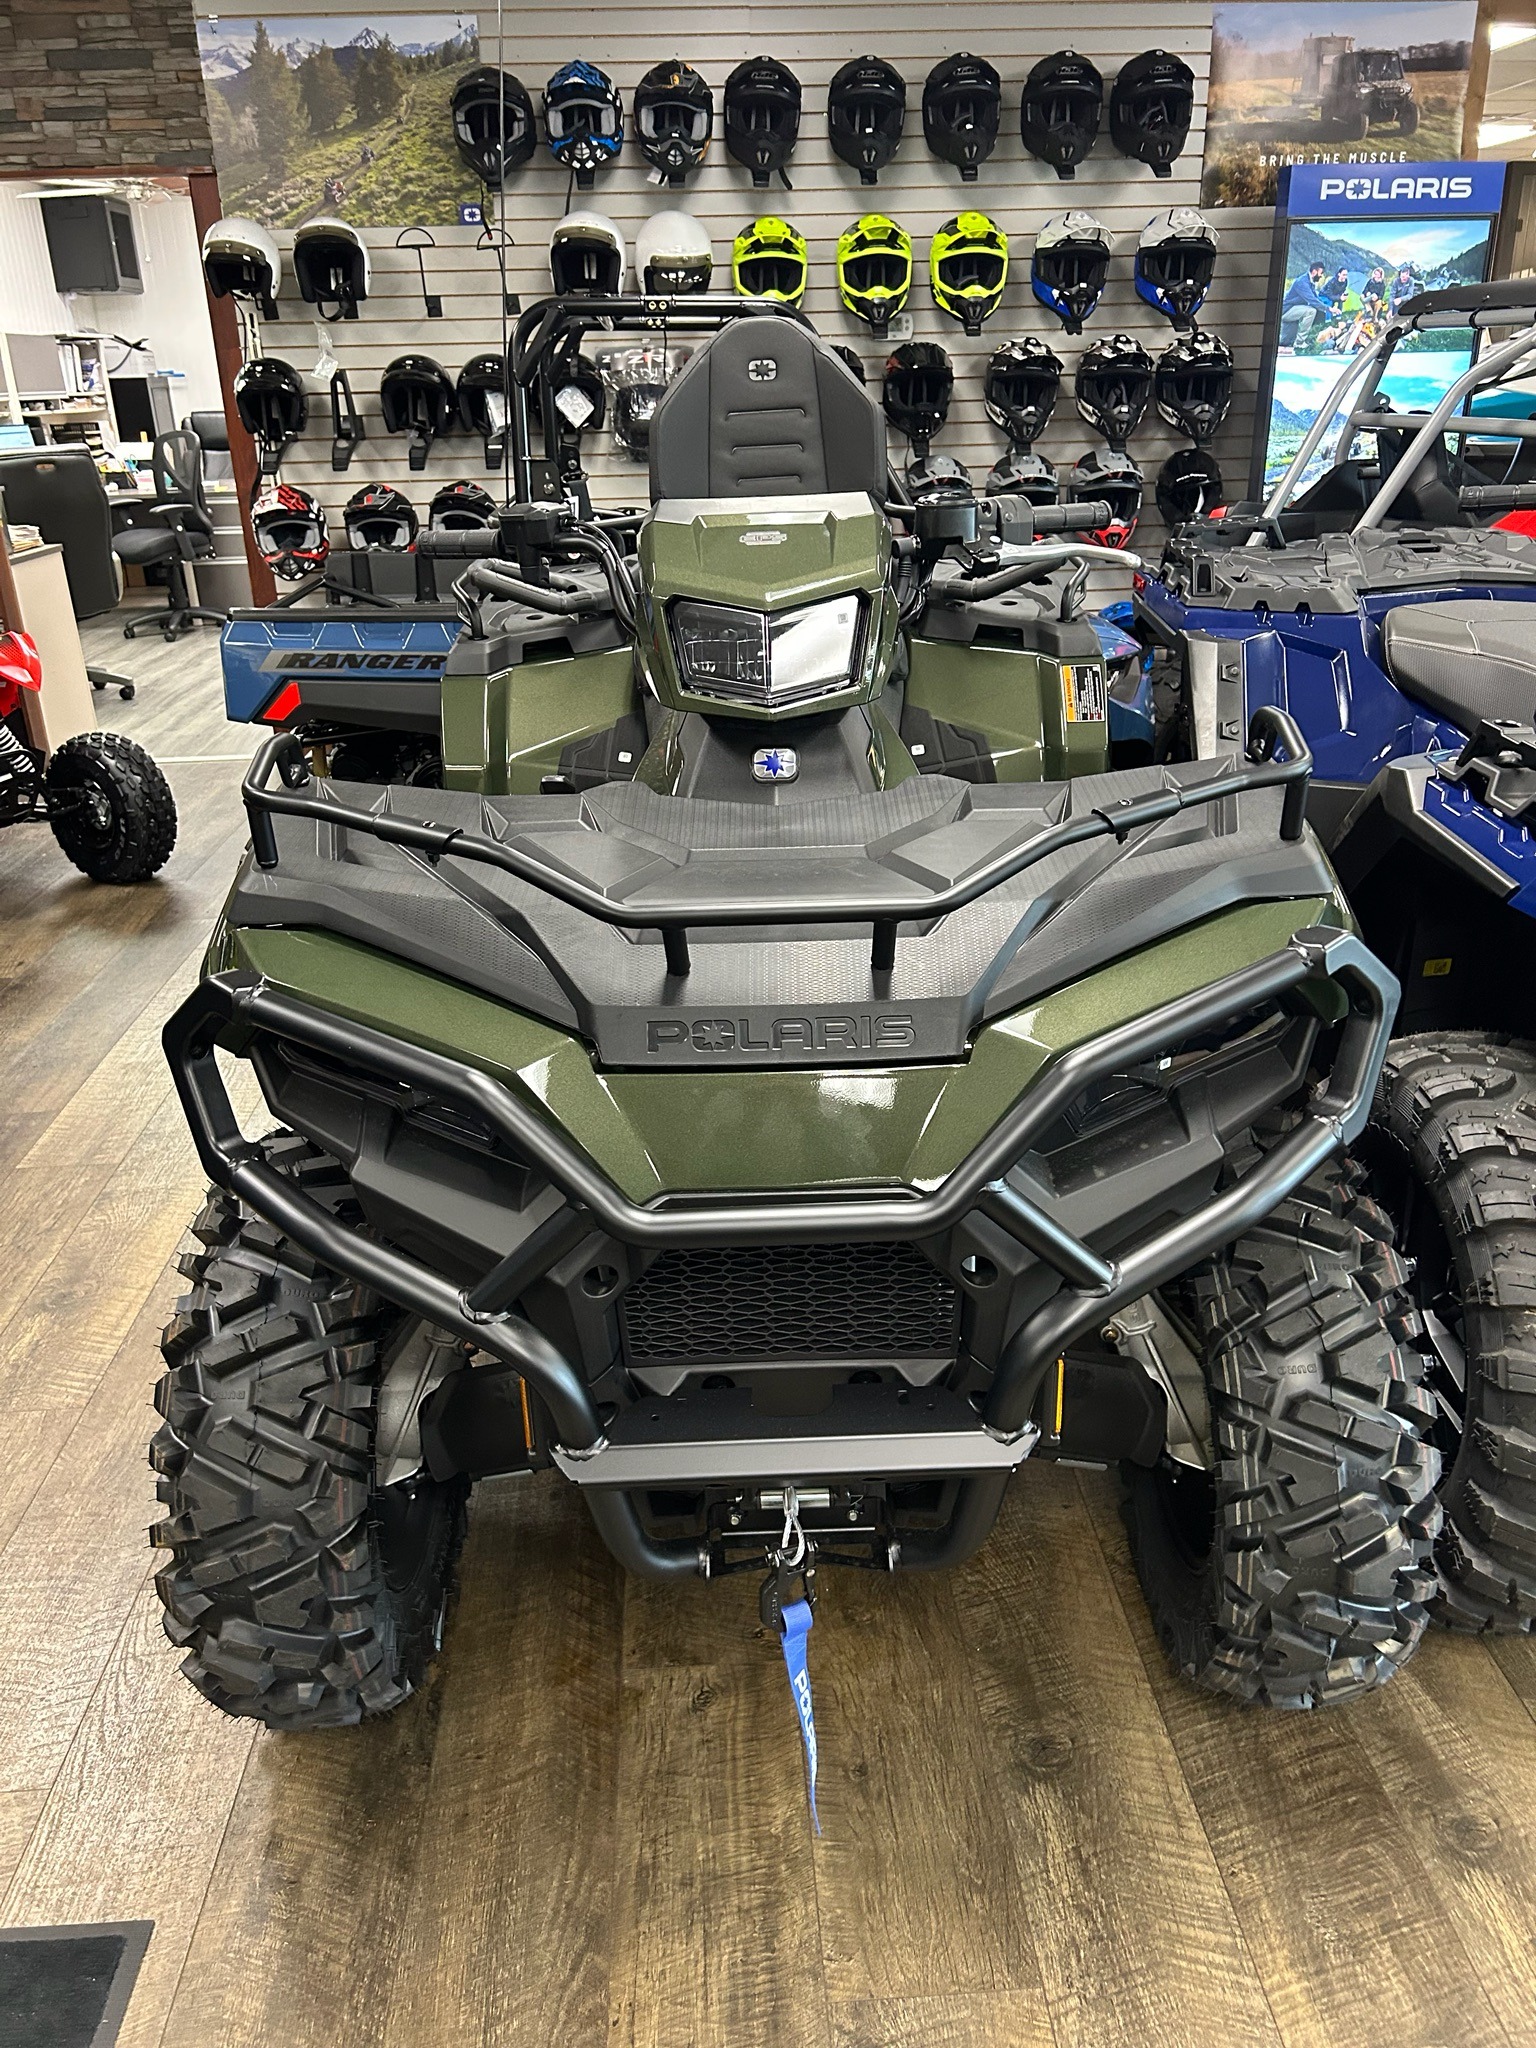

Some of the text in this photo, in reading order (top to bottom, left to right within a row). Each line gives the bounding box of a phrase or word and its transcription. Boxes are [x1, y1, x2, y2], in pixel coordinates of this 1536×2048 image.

[1259, 151, 1407, 167] BRING THE MUSCLE
[1320, 177, 1472, 200] POLARIS
[277, 653, 447, 670] RANGER
[646, 1015, 916, 1053] POLARIS
